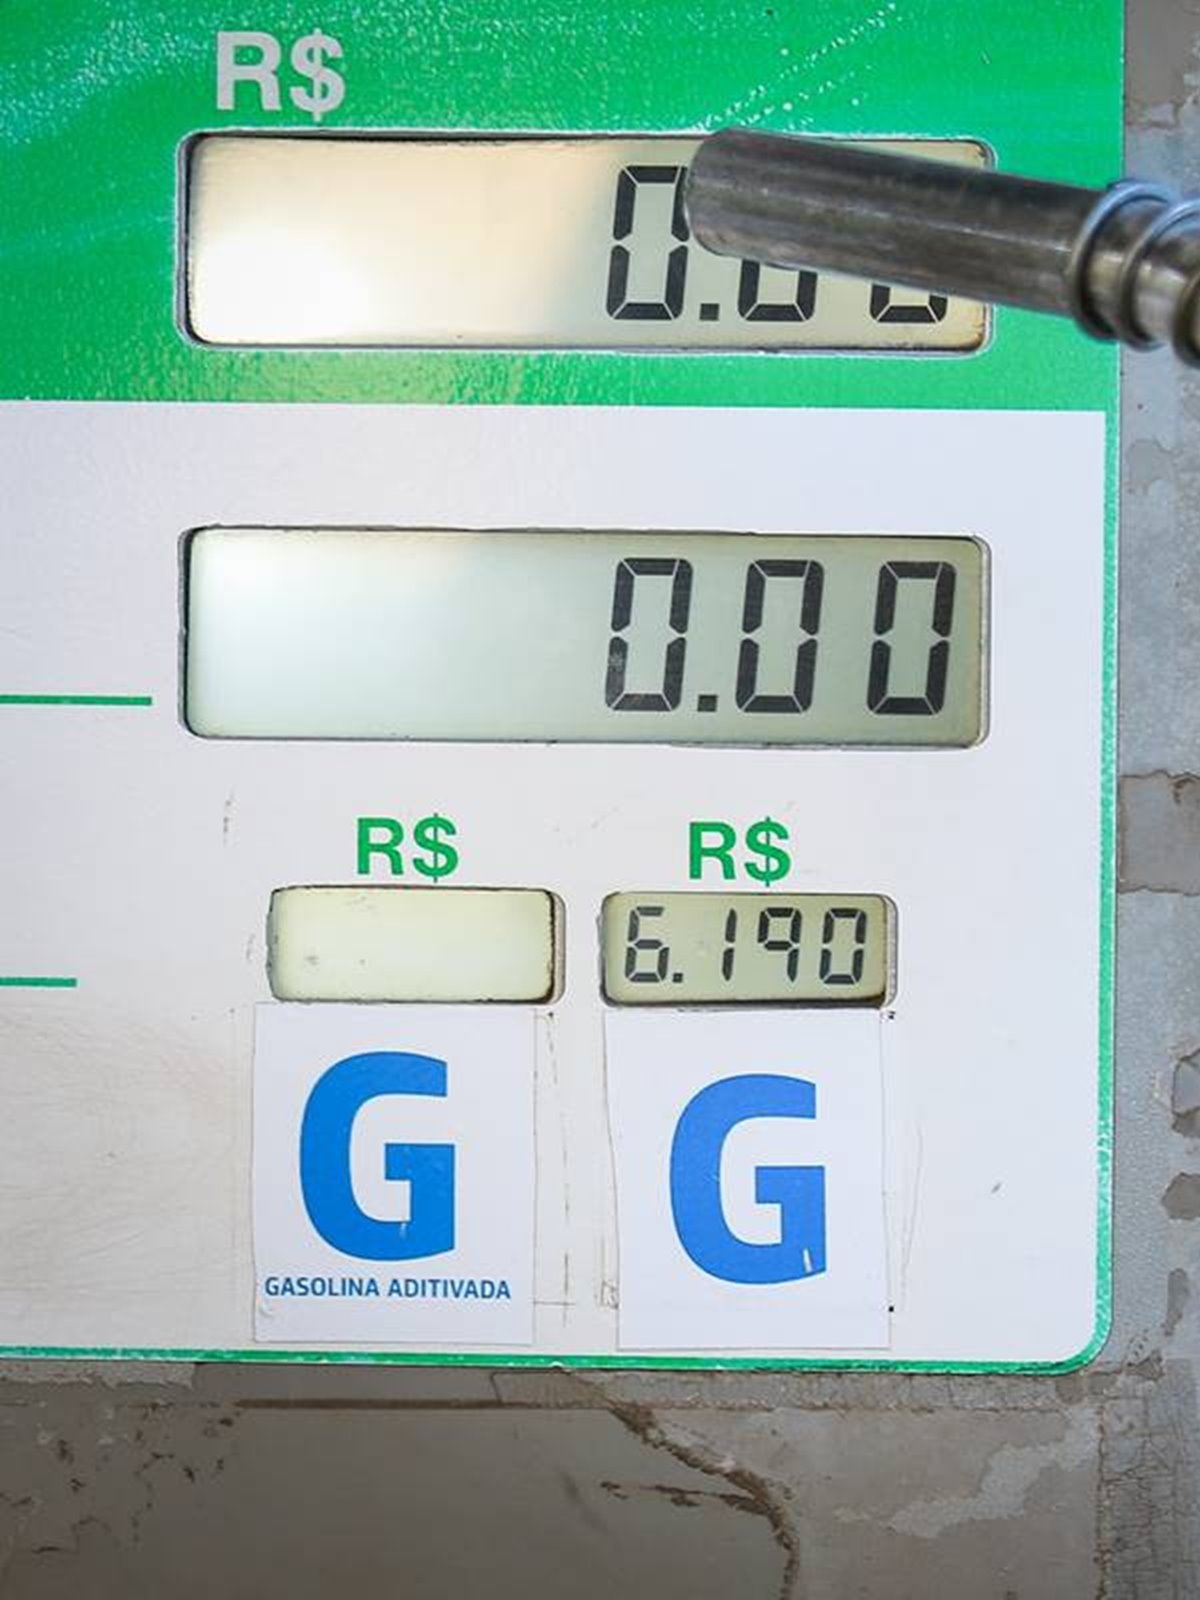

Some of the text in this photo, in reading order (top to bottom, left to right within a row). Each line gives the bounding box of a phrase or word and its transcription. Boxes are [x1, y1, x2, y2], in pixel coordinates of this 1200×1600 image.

[215, 28, 346, 122] R$
[605, 557, 957, 716] 0.00
[355, 813, 460, 882] R$
[688, 817, 791, 888] R$
[625, 906, 868, 985] 6.190
[299, 1050, 457, 1262] G
[669, 1073, 827, 1285] G
[264, 1276, 512, 1301] GASOLINA ADITIVADA
